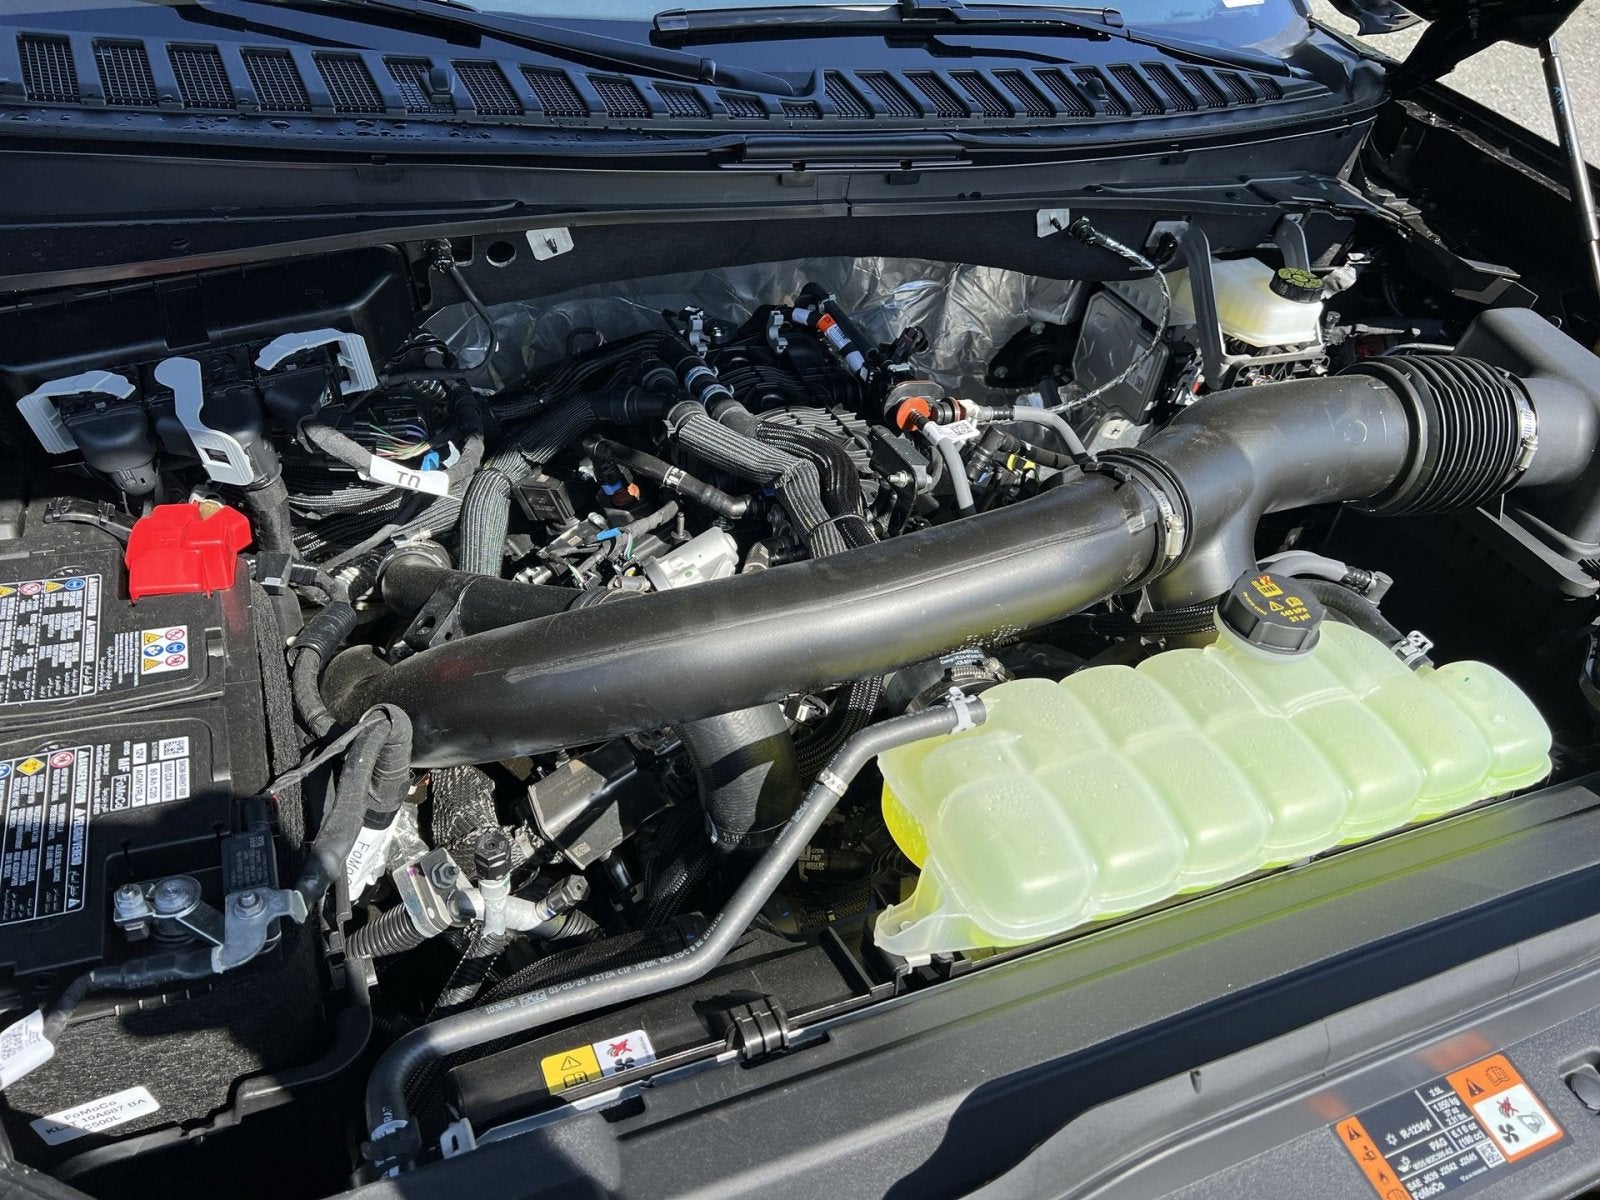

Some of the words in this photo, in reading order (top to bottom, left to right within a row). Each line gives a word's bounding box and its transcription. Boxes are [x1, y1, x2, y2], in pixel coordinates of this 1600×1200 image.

[135, 747, 145, 760] 12V
[117, 756, 131, 773] MF
[133, 769, 145, 802] AGM/VRLA
[149, 778, 158, 787] Ah
[114, 775, 128, 810] FoMoCo
[548, 979, 588, 994] 03/03/26
[63, 1100, 118, 1121] FoMoCo
[126, 1097, 147, 1109] BA
[82, 1114, 122, 1132] C500L
[1399, 1117, 1433, 1140] R-1234yf
[1428, 1136, 1449, 1152] PAG
[1406, 1178, 1424, 1192] SAE
[1411, 1181, 1446, 1200] FoMoCo
